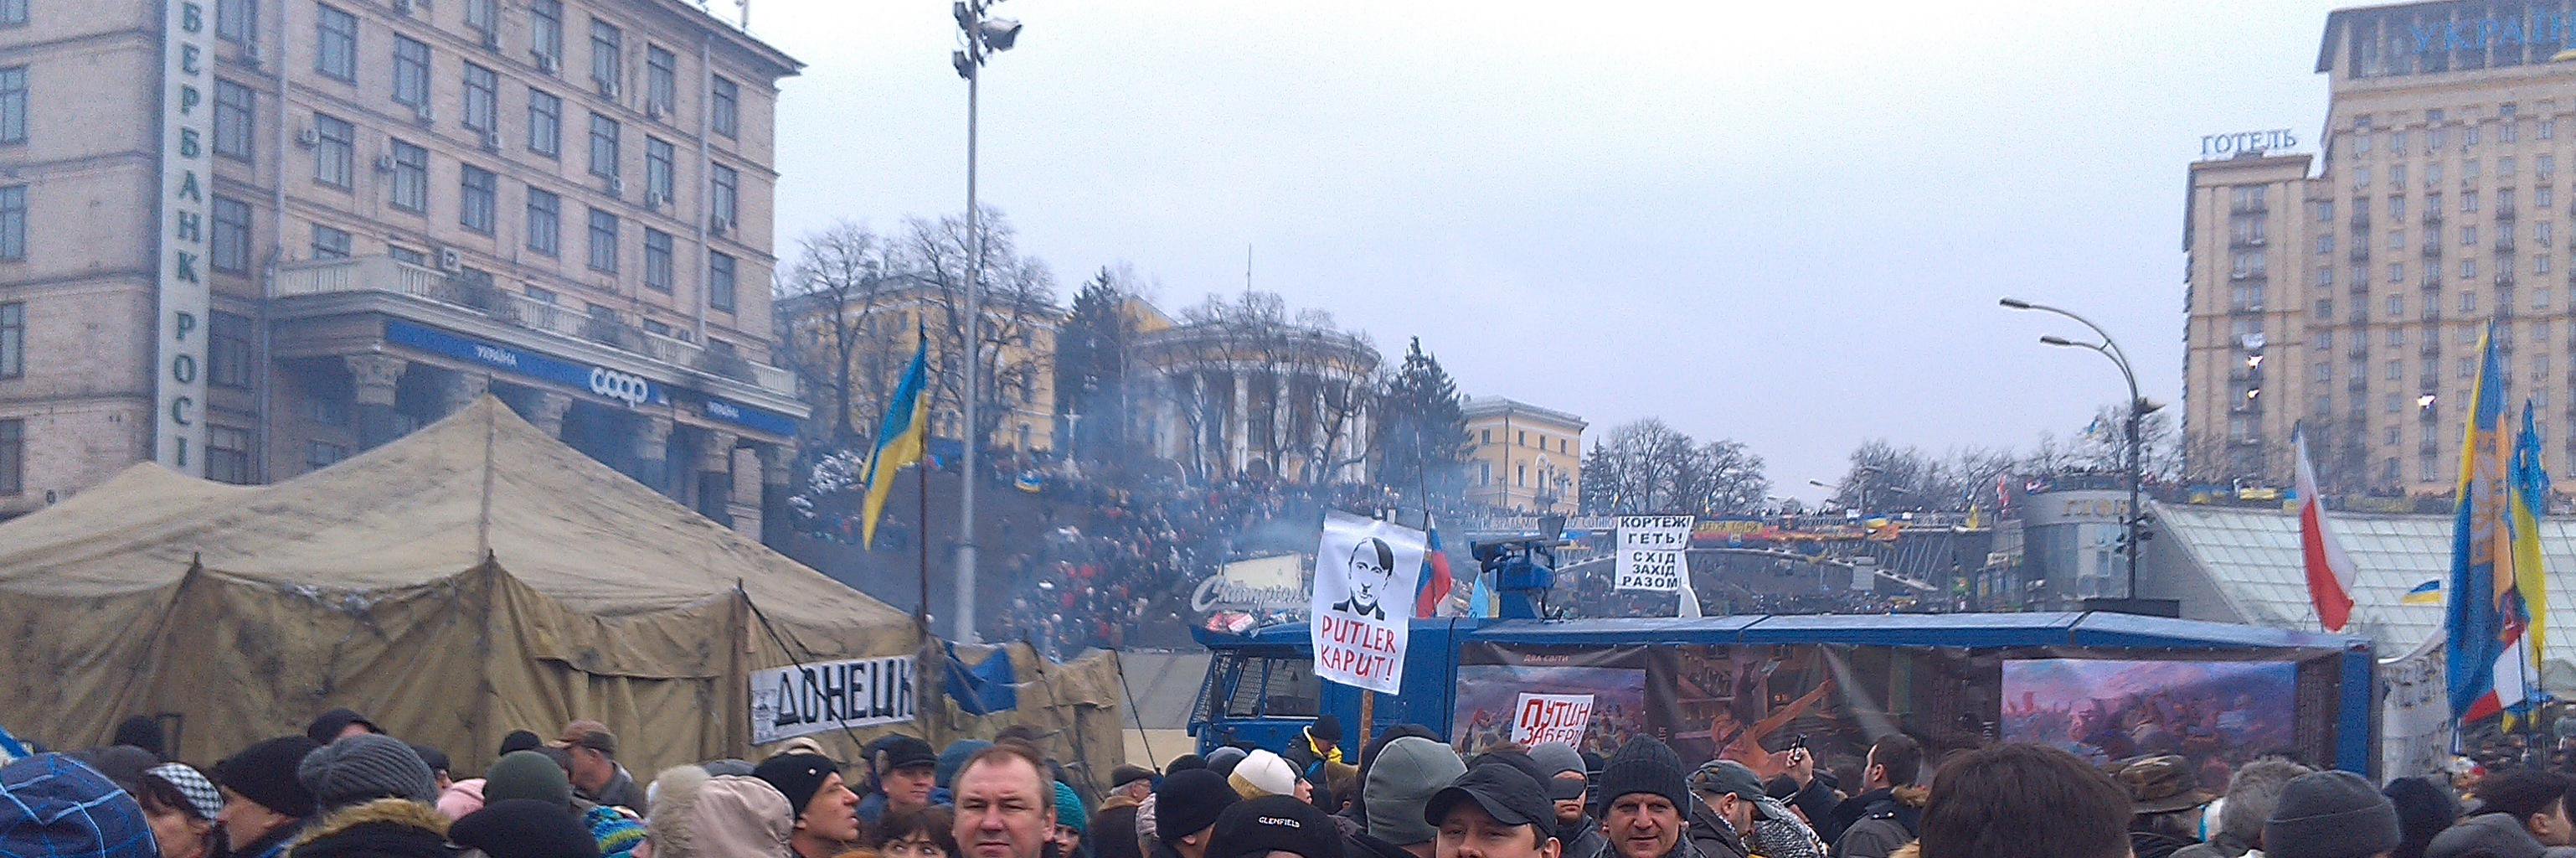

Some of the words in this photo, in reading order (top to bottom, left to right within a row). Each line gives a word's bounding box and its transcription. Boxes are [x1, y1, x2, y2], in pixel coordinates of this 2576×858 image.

[2201, 128, 2296, 155] ГОТЕЛЬ
[1628, 532, 1682, 545] ГЕТЬ!
[1633, 551, 1676, 566] СХІД
[1632, 564, 1676, 577] ЗАХІД
[1321, 615, 1396, 654] PUTLER
[1321, 644, 1394, 681] KAPUT!
[1521, 699, 1591, 729] ПУТИН
[1259, 816, 1301, 828] GLENFIELD
